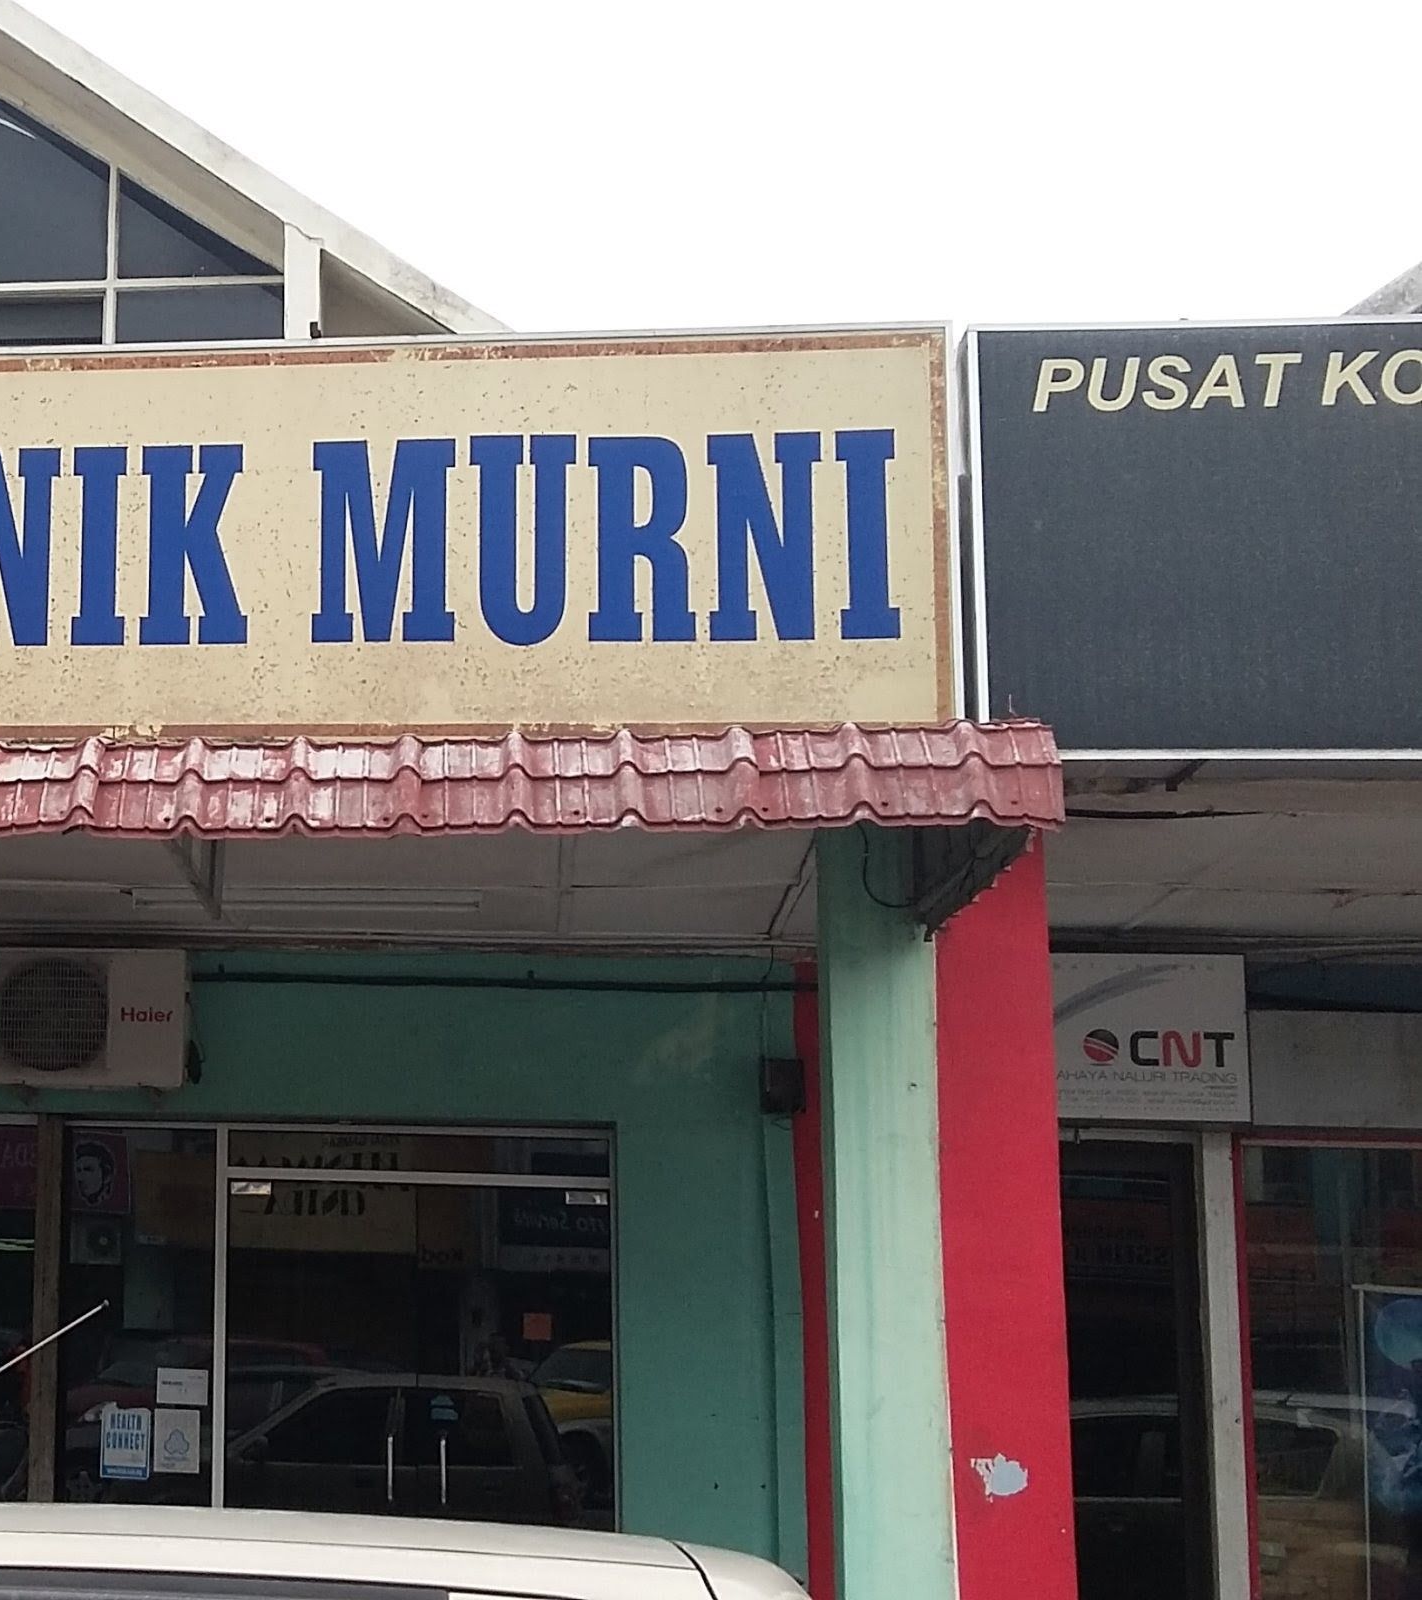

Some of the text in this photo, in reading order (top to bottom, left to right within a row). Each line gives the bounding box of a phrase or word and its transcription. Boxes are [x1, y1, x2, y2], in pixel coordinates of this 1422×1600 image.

[1032, 353, 1302, 412] PUSAT
[311, 429, 901, 646] MURNI
[120, 1006, 173, 1022] Haier
[1130, 1030, 1236, 1068] CNT
[1113, 1070, 1166, 1082] NALURI
[1169, 1071, 1237, 1084] TRADING
[110, 1413, 142, 1430] HEALTH
[105, 1431, 145, 1451] CONNECT
